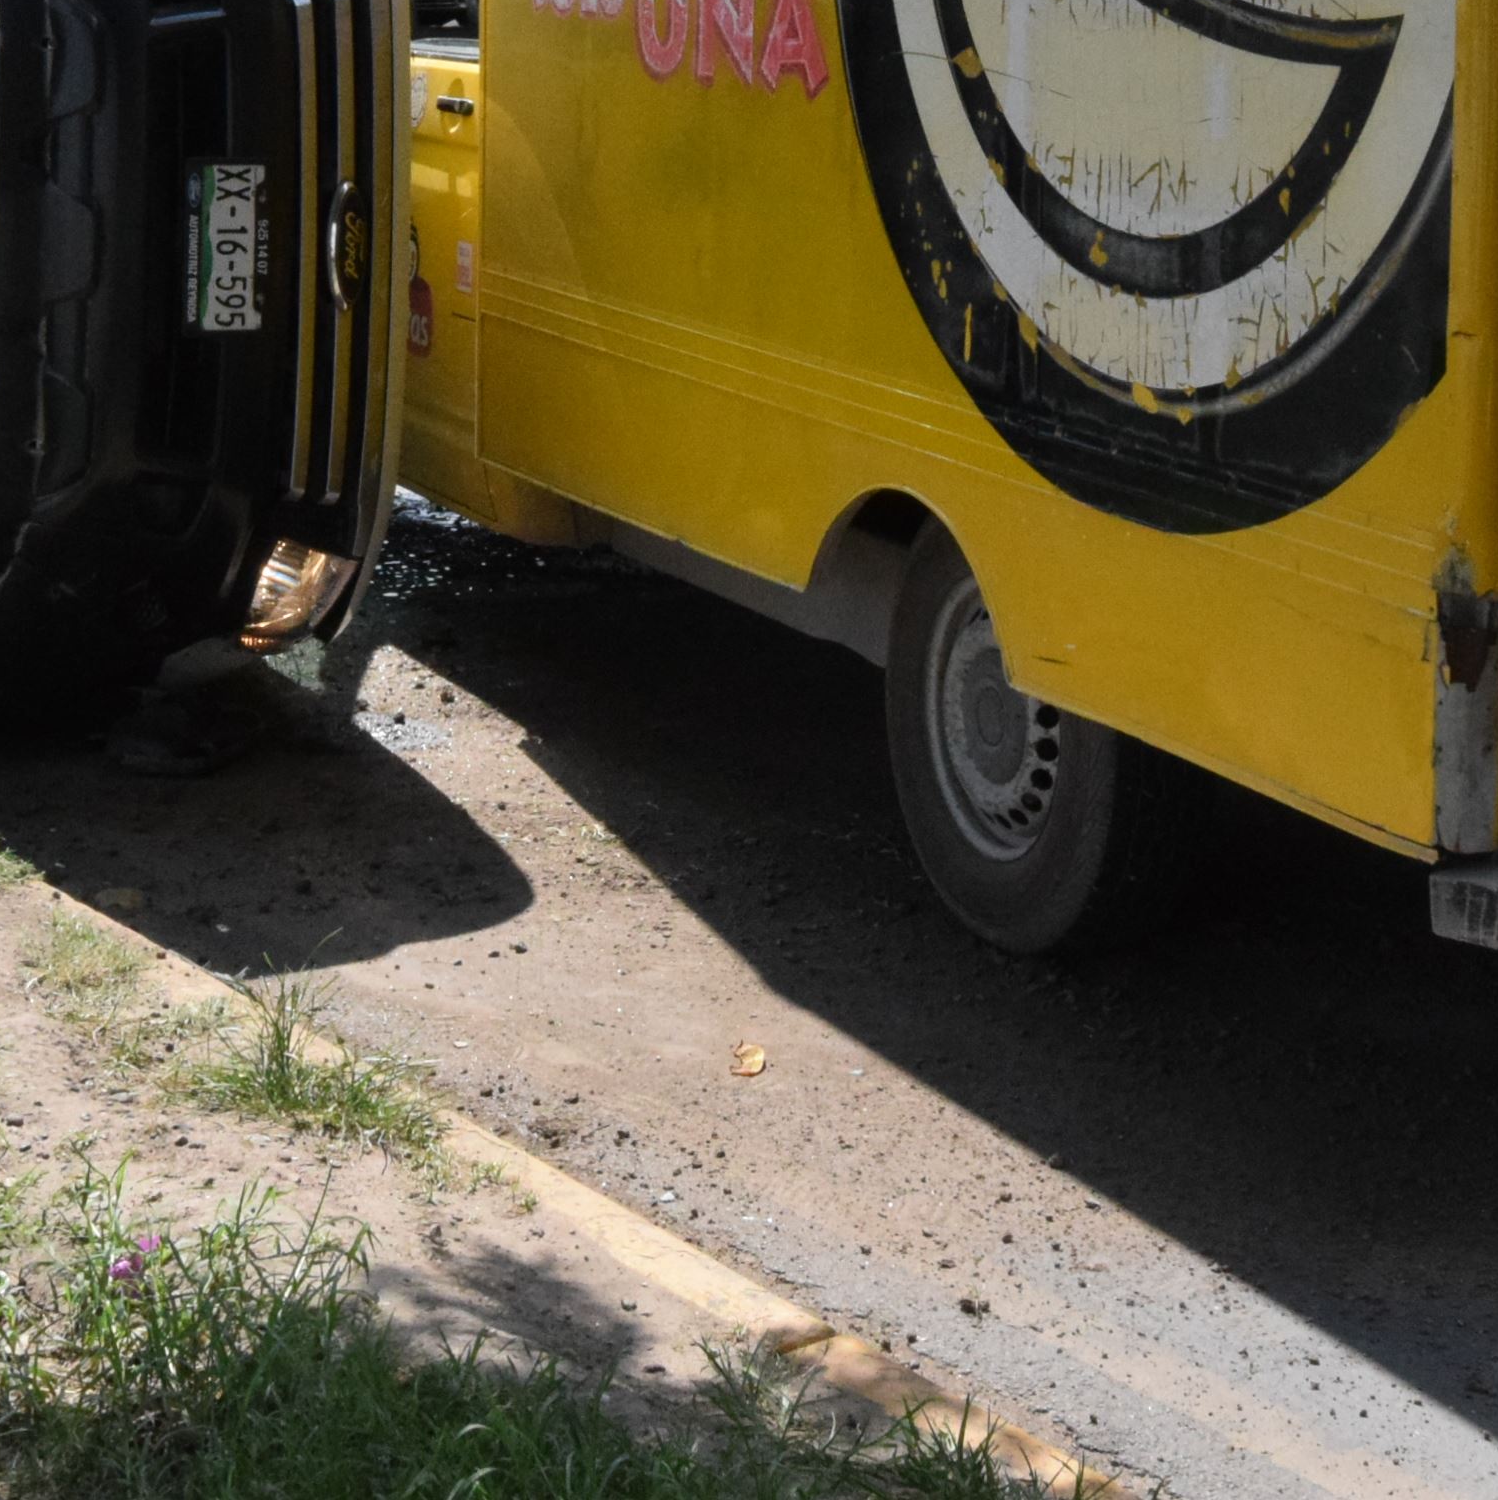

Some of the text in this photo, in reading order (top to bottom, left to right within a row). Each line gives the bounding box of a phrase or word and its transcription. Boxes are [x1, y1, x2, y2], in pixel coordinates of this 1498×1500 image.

[186, 214, 199, 323] AUTOMOTRIZ REYNOSA
[215, 167, 251, 328] XX-16-595
[257, 219, 269, 276] 925 14 07
[344, 211, 365, 280] Ford
